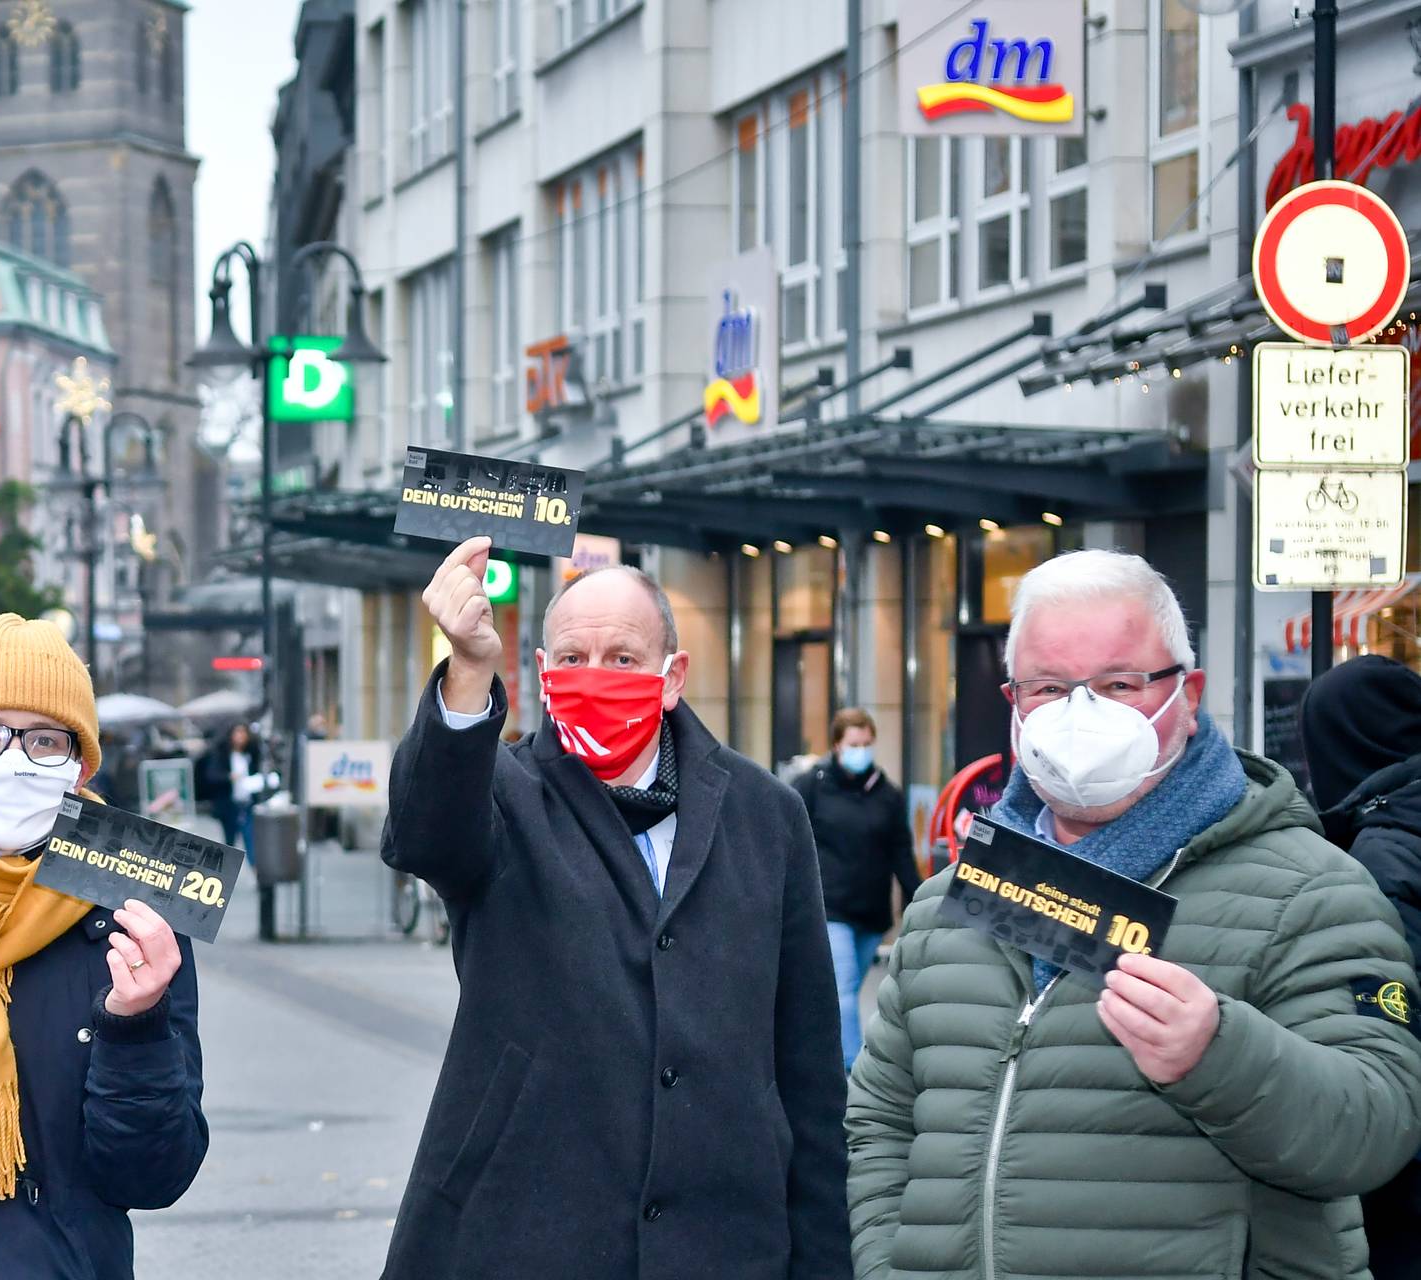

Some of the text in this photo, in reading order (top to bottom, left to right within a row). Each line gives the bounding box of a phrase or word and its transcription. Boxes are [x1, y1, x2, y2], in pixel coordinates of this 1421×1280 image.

[945, 18, 1054, 82] dm
[716, 288, 751, 376] dm
[283, 348, 347, 409] D
[1286, 362, 1377, 385] Liefer-
[1280, 397, 1384, 418] verkehr
[1310, 430, 1354, 451] frei
[402, 488, 524, 519] DEIN GUTSCHEIN
[469, 486, 525, 503] deine stadt
[534, 496, 571, 526] 10€
[330, 752, 373, 777] dm
[49, 837, 174, 891] DEIN GUTSCHEIN
[119, 848, 176, 875] deine stadt
[180, 870, 225, 909] 20€
[957, 863, 1097, 935] DEIN GUTSCHEIN
[1035, 881, 1102, 917] deine stadt
